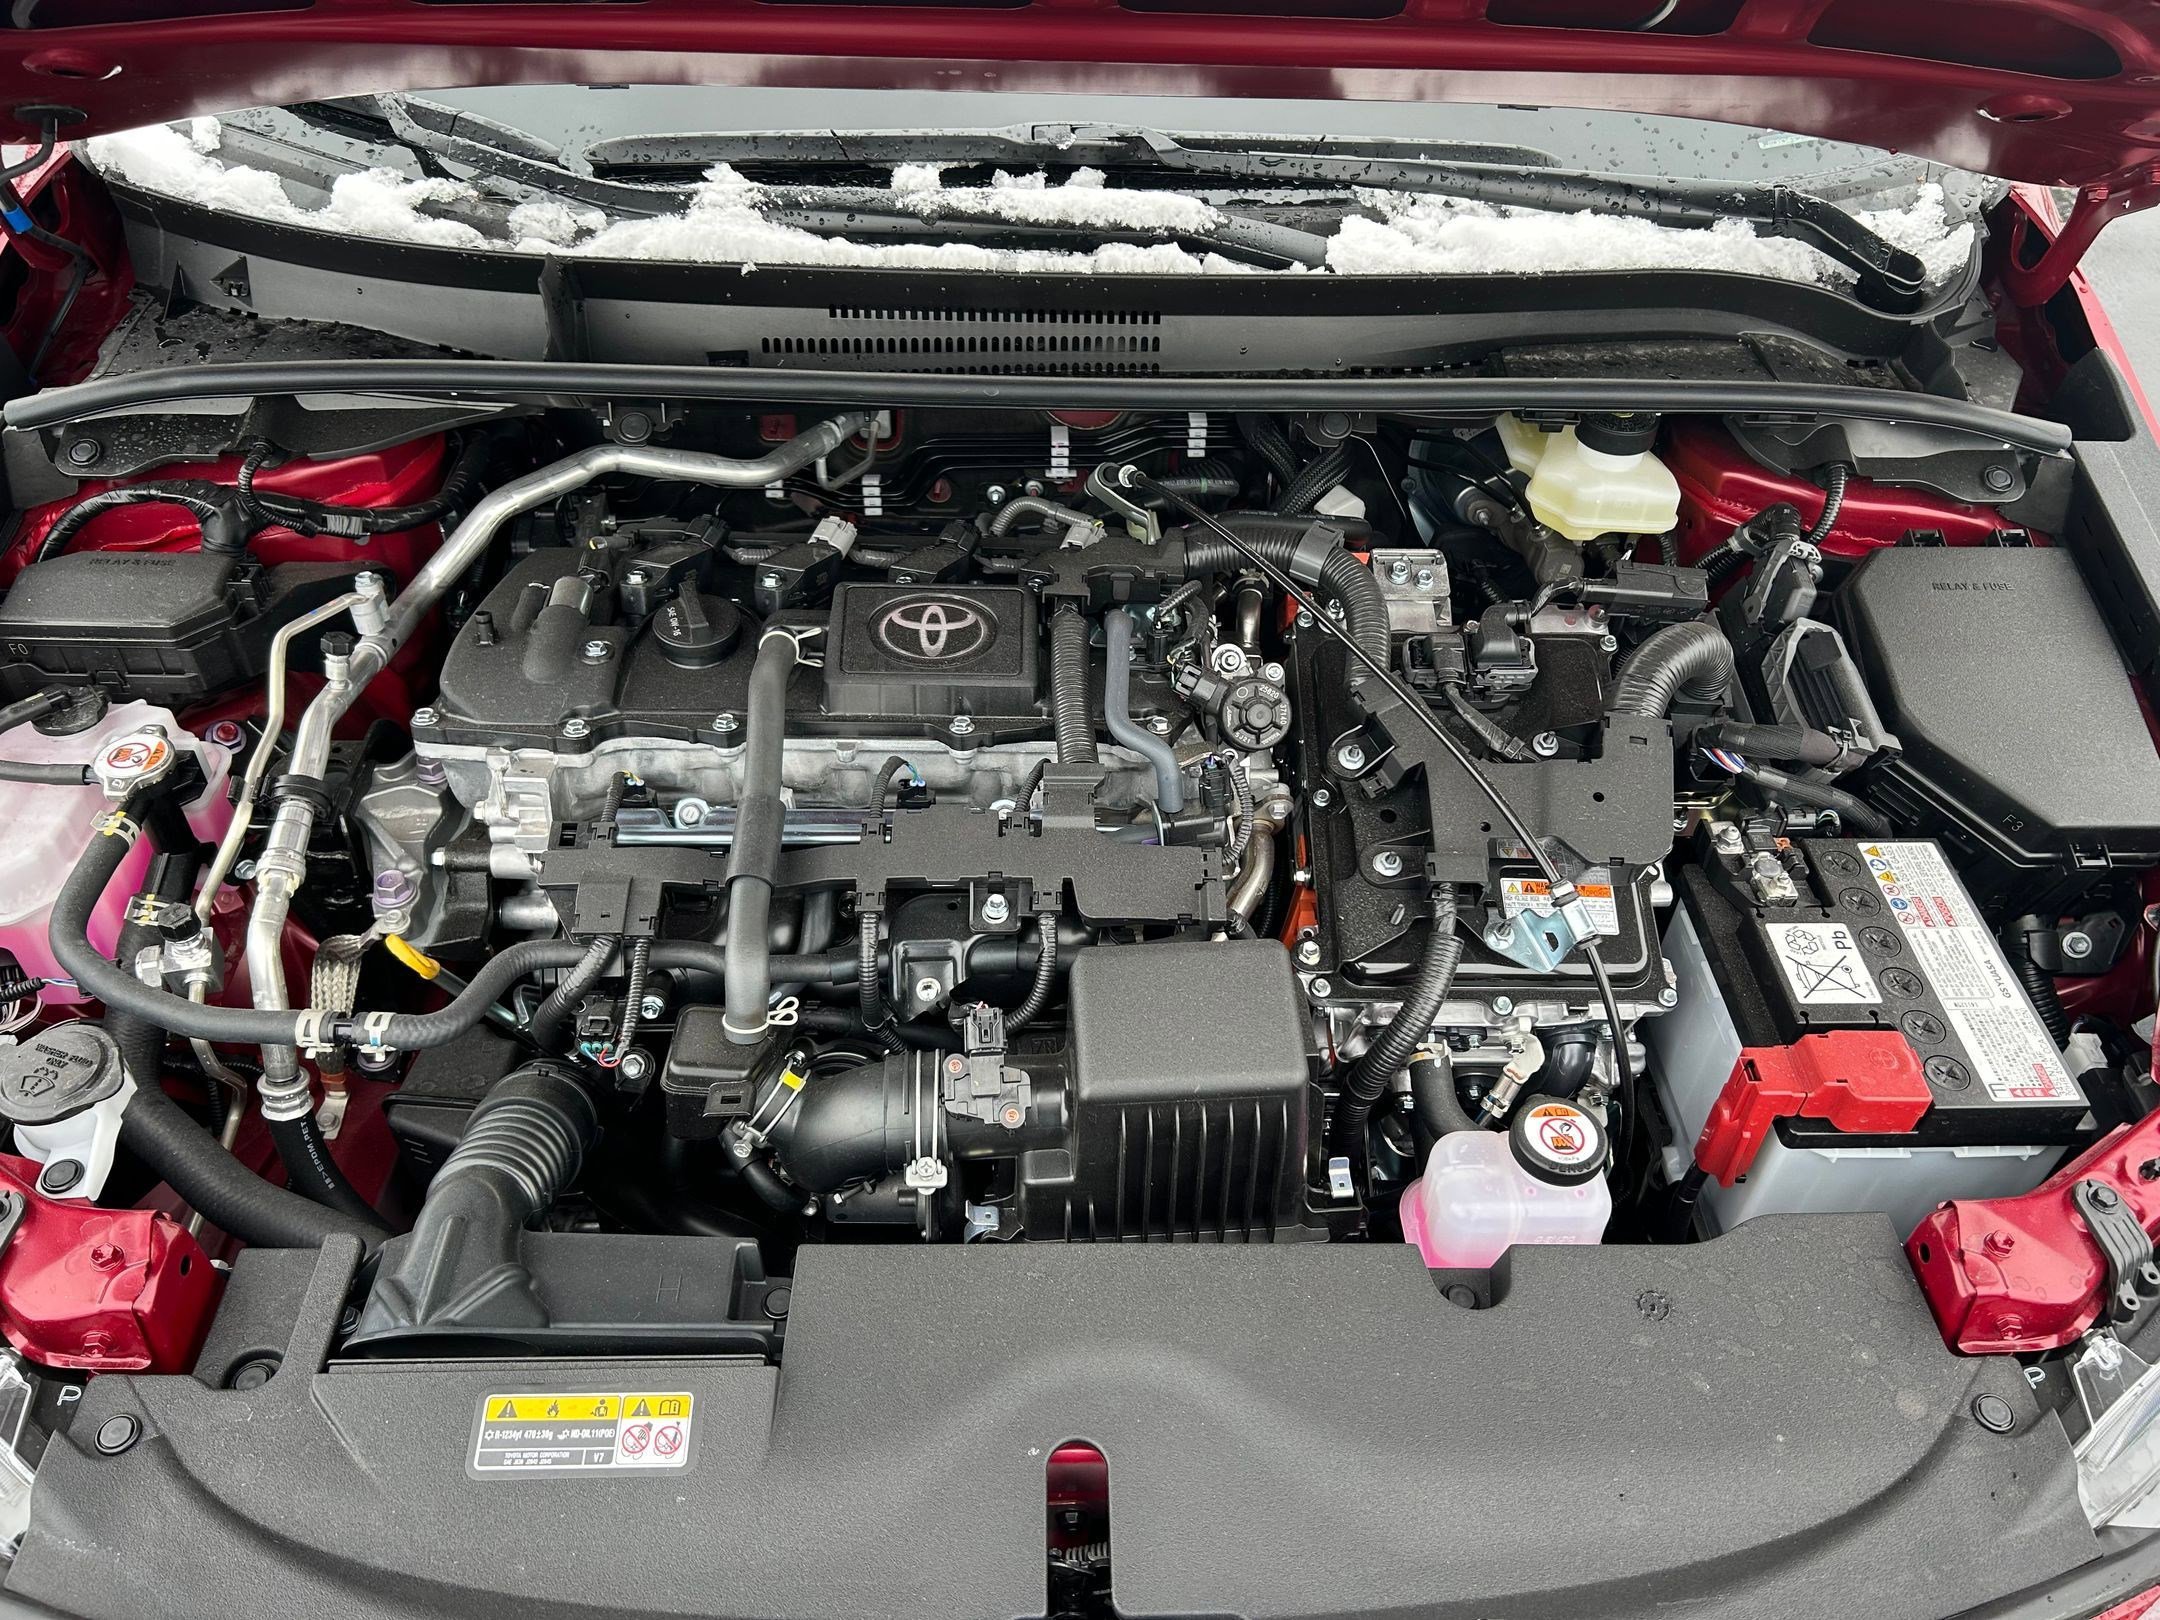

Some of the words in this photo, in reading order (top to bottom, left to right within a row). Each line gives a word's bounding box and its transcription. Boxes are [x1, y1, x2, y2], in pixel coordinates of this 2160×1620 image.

[143, 559, 177, 567] FUSE
[1932, 582, 1969, 591] RELAY
[1982, 582, 2015, 591] FUSE
[2002, 814, 2024, 832] F3
[1832, 930, 1853, 950] Pb
[1983, 959, 2004, 987] YUASA
[1999, 986, 2012, 999] GS
[2023, 1366, 2047, 1390] P
[57, 1385, 82, 1406] P
[522, 1451, 538, 1459] MOTOR
[539, 1451, 570, 1459] CORPORATION
[593, 1452, 605, 1463] V7
